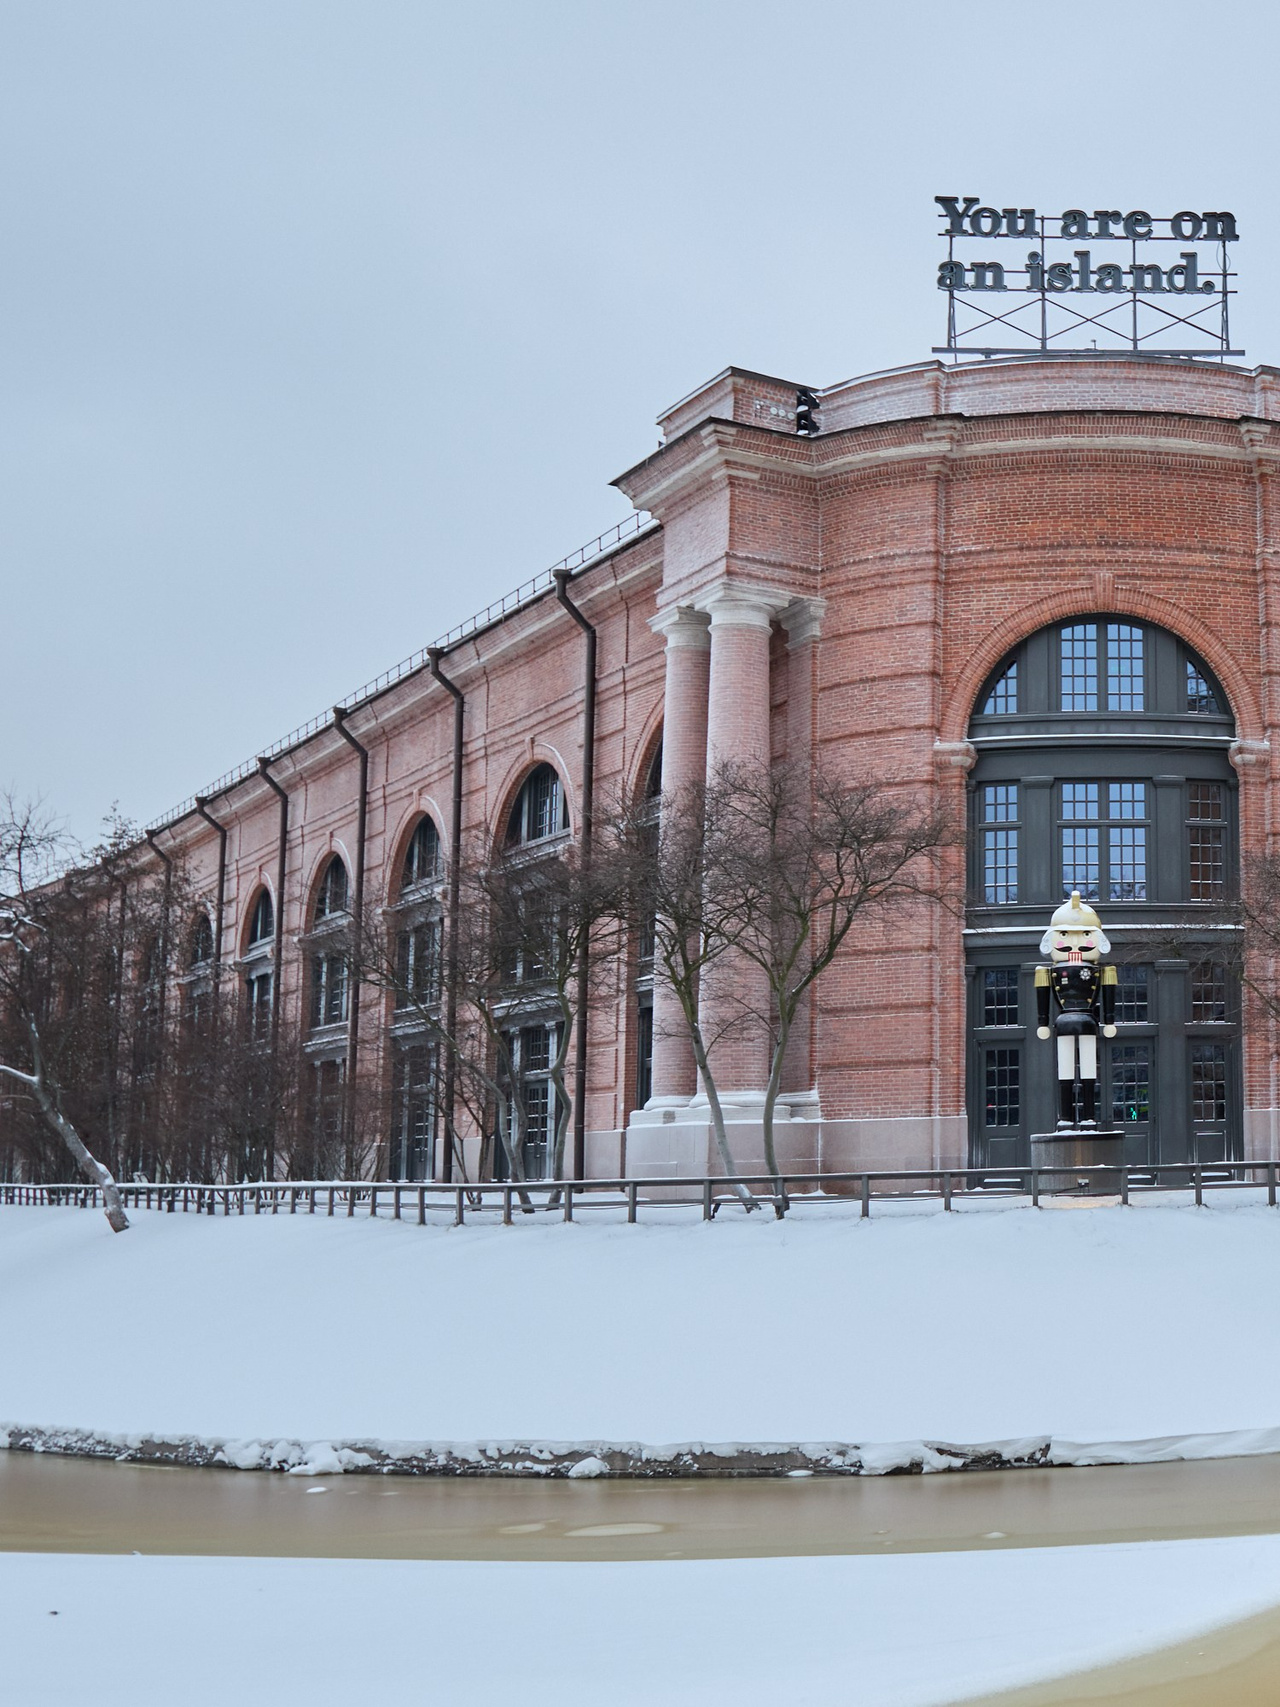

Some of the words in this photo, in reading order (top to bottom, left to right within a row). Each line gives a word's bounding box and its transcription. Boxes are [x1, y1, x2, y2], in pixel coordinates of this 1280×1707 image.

[934, 195, 1040, 238] You
[1061, 209, 1153, 240] are
[1171, 210, 1239, 241] on
[937, 260, 1007, 292] an
[1025, 251, 1216, 294] island.
